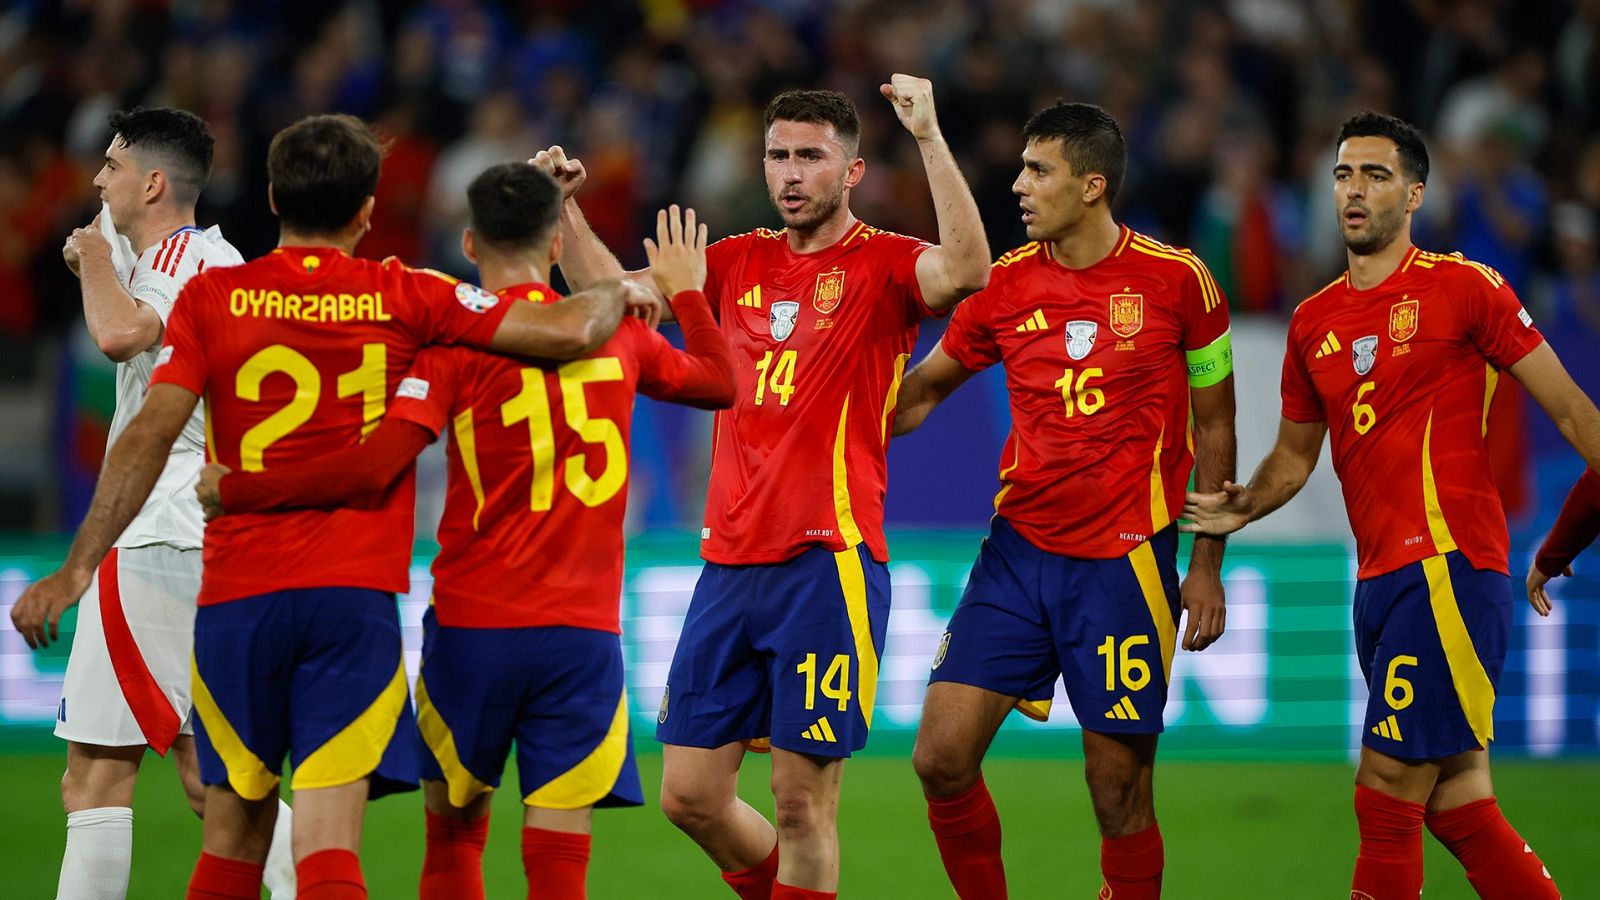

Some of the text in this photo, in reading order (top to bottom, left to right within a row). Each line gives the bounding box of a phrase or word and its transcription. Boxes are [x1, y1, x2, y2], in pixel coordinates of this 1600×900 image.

[230, 288, 391, 322] OYARZABAL
[755, 350, 798, 405] 14
[1054, 367, 1106, 418] 16
[1187, 361, 1216, 375] ESPECT
[236, 343, 387, 472] 21
[501, 357, 627, 511] 15
[1352, 380, 1377, 436] 6
[796, 653, 852, 712] 14
[1097, 634, 1151, 692] 16
[1384, 654, 1418, 711] 6
